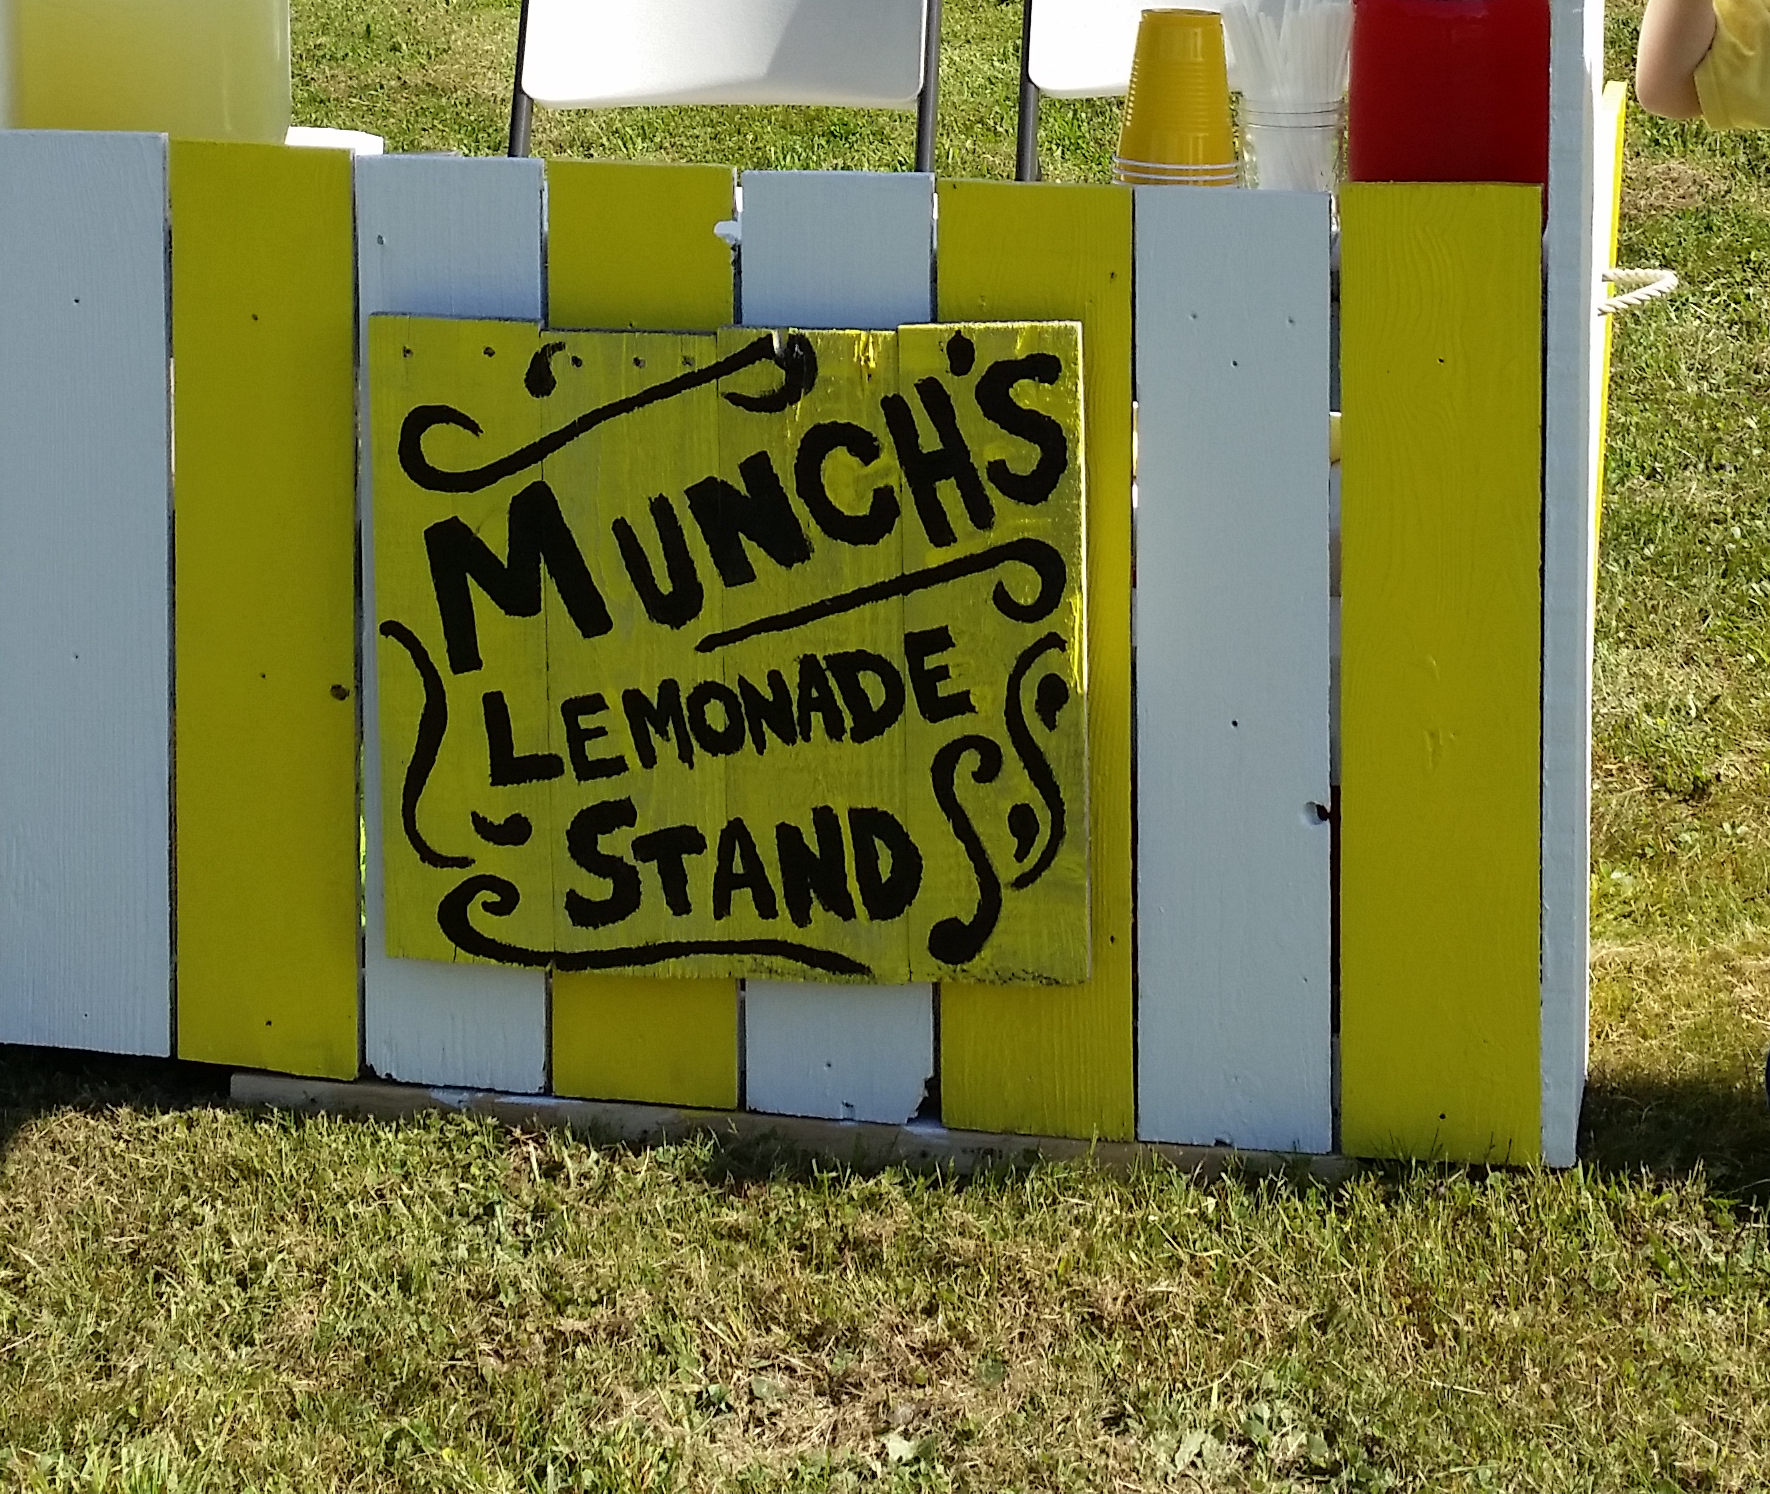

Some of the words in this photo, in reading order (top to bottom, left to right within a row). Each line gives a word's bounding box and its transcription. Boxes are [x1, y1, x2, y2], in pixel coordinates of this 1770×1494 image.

[424, 331, 1068, 674] MUNCH'S
[483, 627, 976, 787] LEMONADE
[564, 798, 923, 929] STAND
